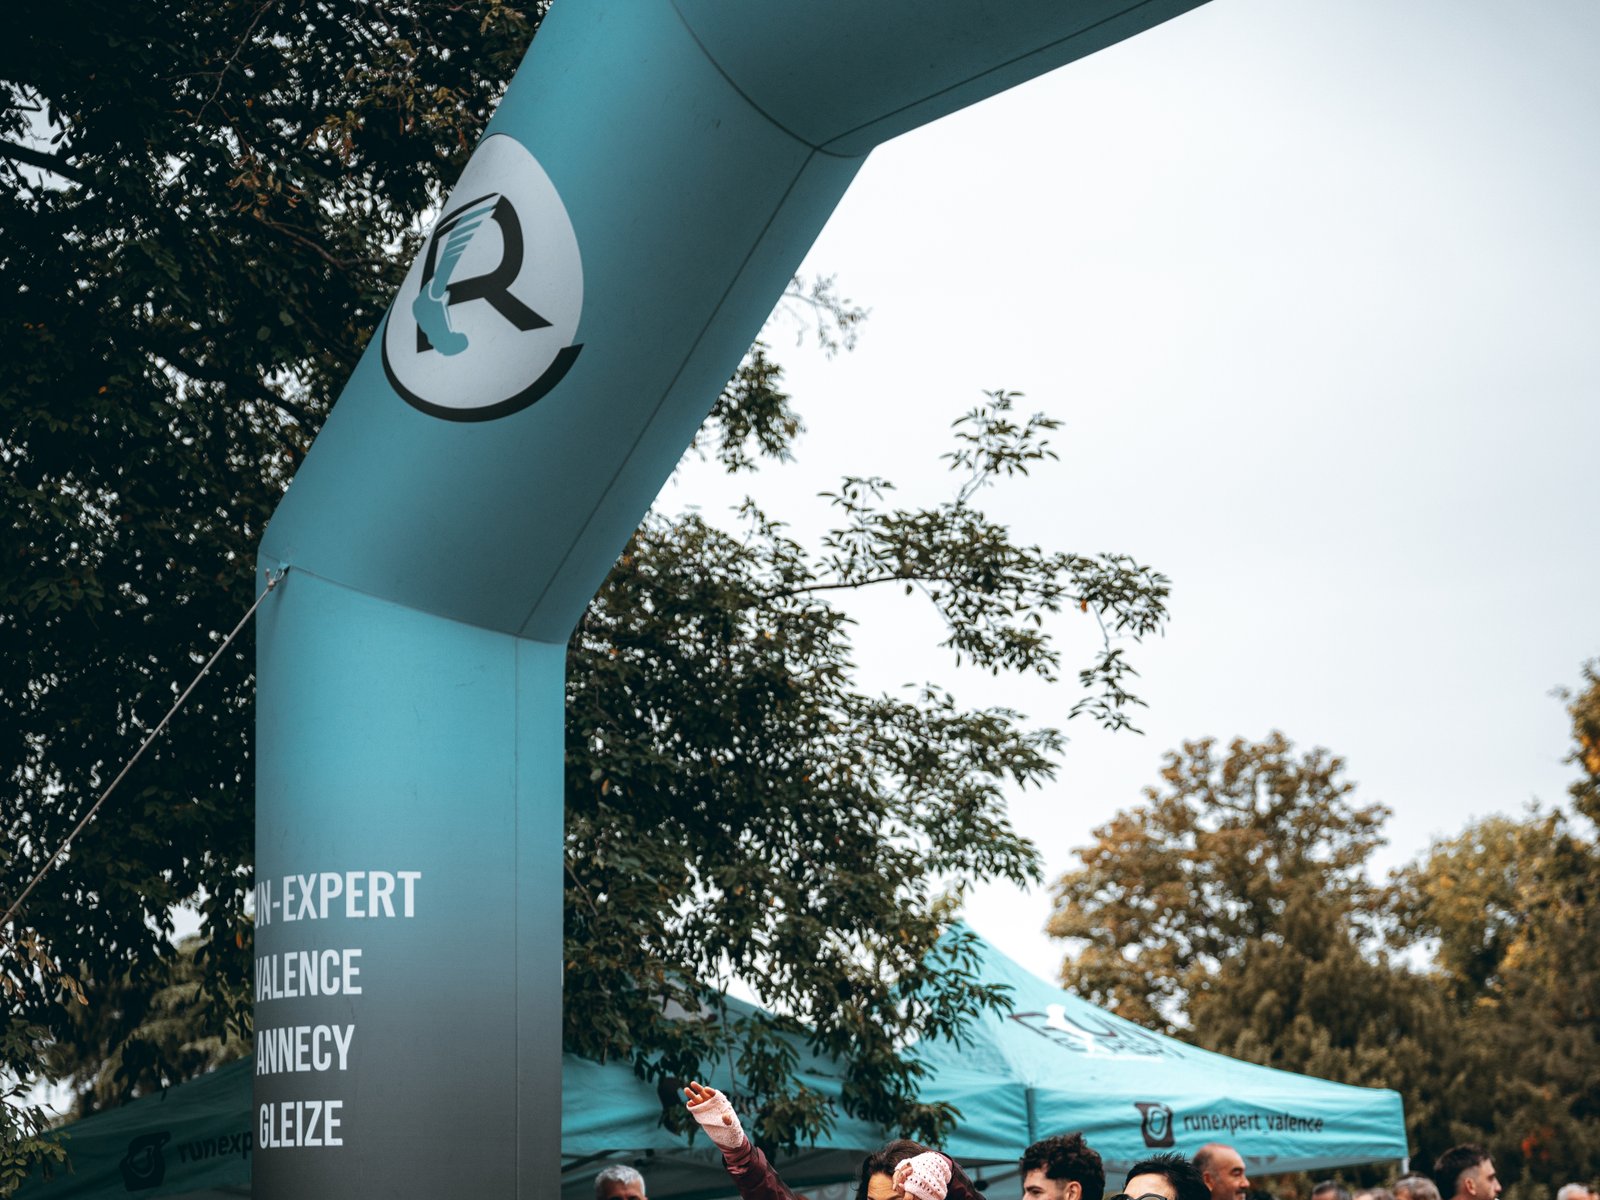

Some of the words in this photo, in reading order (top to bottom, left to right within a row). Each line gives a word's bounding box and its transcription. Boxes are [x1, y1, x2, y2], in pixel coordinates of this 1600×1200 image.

[256, 949, 362, 1002] VALENCE
[257, 1024, 355, 1076] ANNECY
[259, 1100, 343, 1149] GLEIZE
